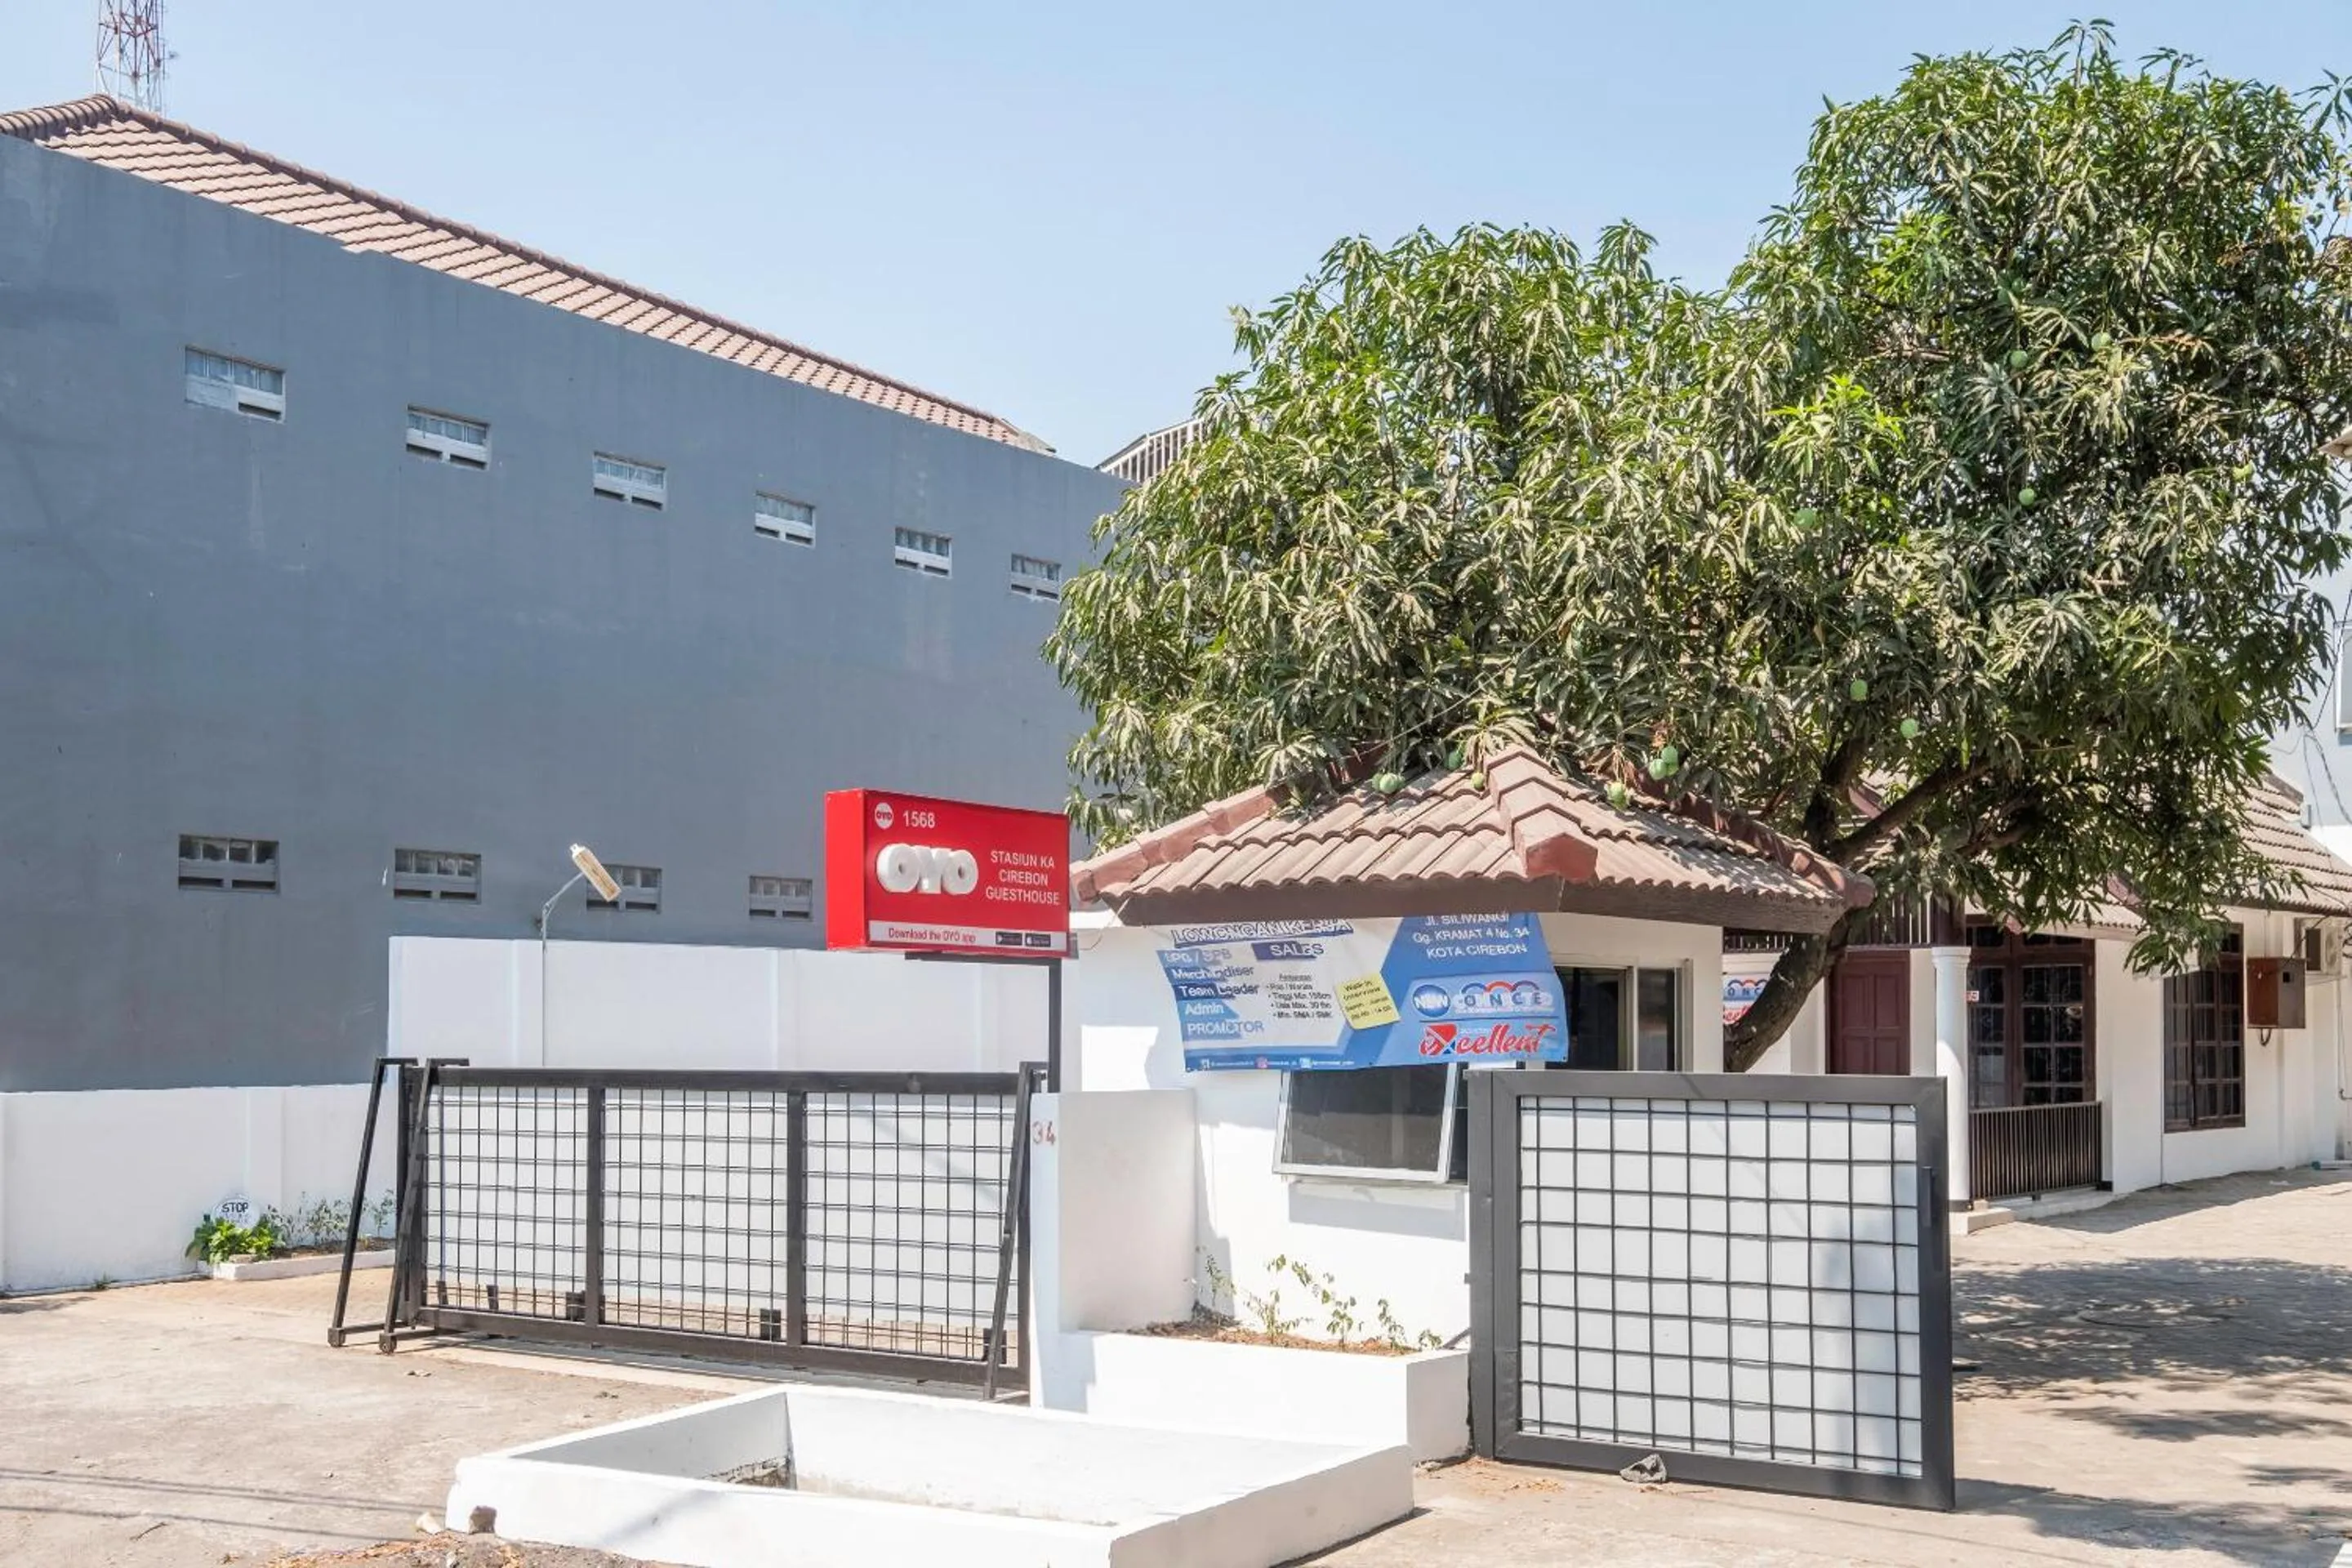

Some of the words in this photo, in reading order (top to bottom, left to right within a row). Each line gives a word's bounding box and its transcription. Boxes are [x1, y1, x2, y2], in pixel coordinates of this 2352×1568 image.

[902, 809, 935, 829] 1568
[990, 850, 1037, 866] STASIUN
[1040, 855, 1054, 868] KA
[877, 843, 978, 895] OYO
[999, 868, 1049, 886] CIREBON
[986, 886, 1060, 906] GUESTHOUSE
[1441, 912, 1510, 925] SILIWANGI
[888, 927, 927, 939] Download
[929, 930, 942, 940] the
[943, 931, 960, 941] OYO
[962, 933, 976, 943] app
[1434, 928, 1483, 941] KRAMAT
[1270, 943, 1325, 956] SALES
[1426, 947, 1465, 959] KOTA
[1466, 943, 1528, 956] CIREBON
[1179, 985, 1215, 997] Team
[1215, 982, 1259, 996] Leader
[1186, 1001, 1224, 1014] Admin
[1187, 1020, 1264, 1036] PROMOTOR
[1032, 1120, 1056, 1146] 34
[221, 1201, 249, 1214] STOP
